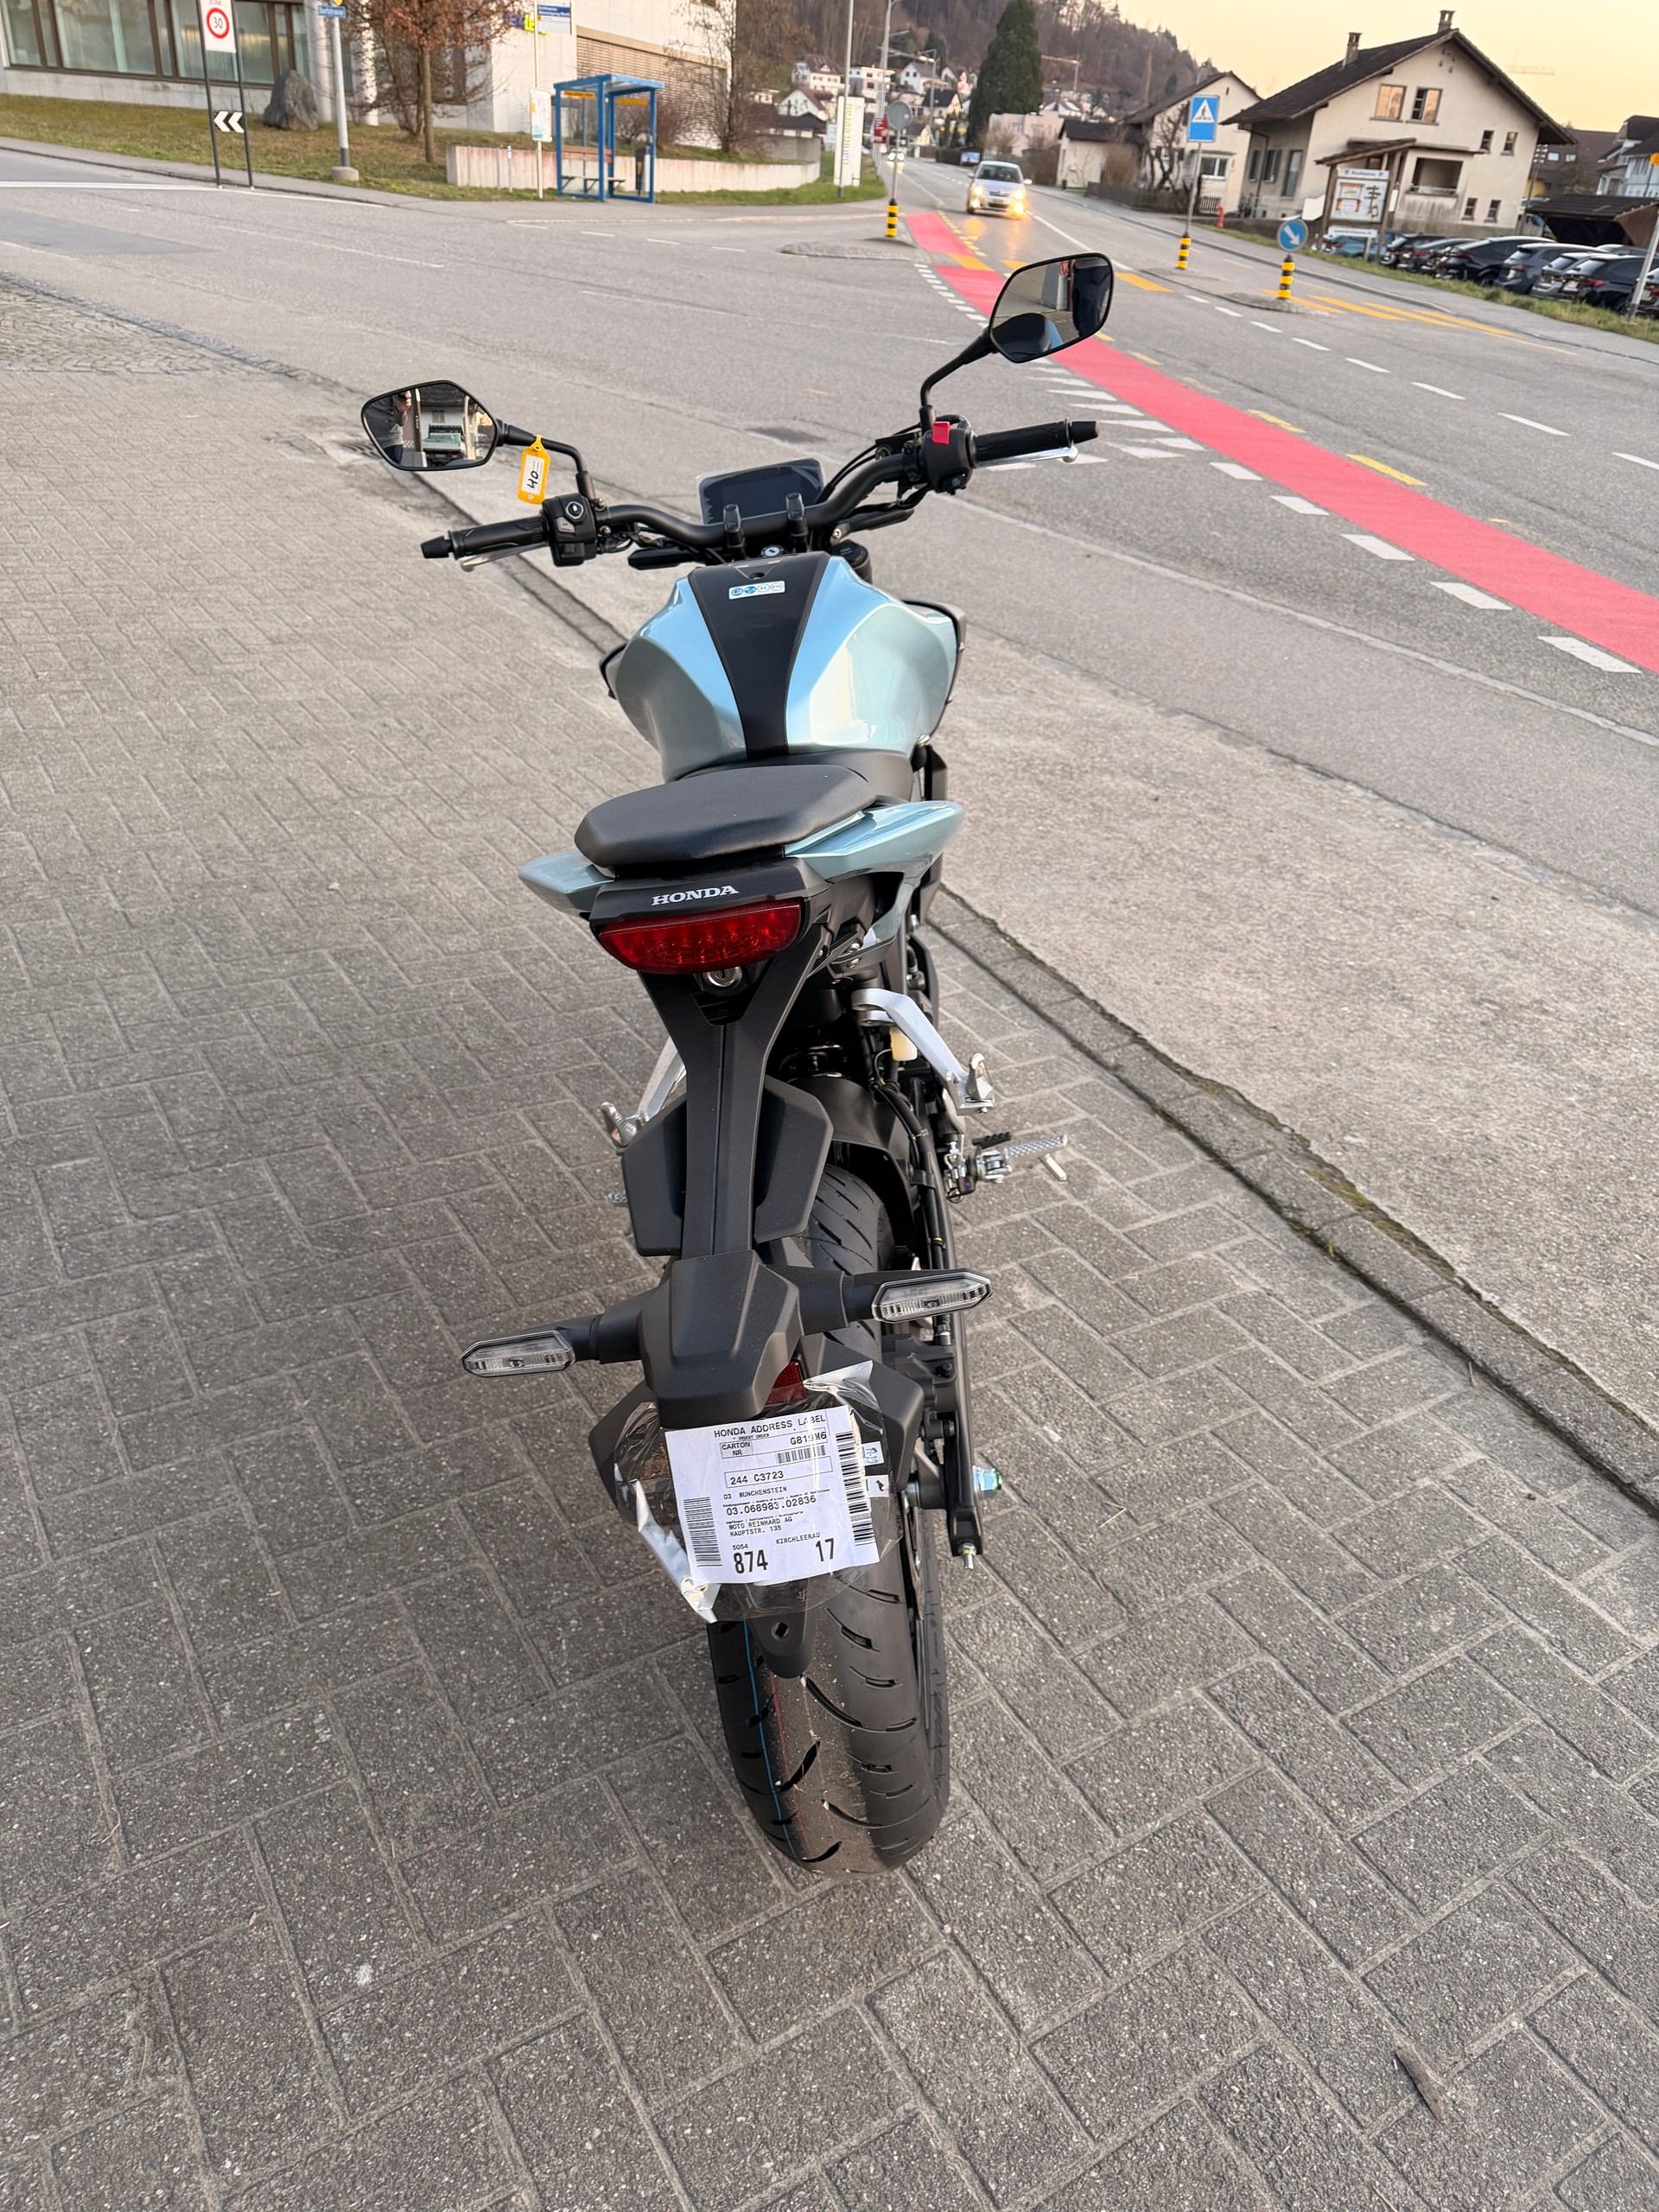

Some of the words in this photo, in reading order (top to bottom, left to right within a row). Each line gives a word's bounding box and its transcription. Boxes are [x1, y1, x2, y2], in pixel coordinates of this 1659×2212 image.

[213, 16, 223, 29] 30
[527, 470, 538, 489] 40
[651, 885, 740, 906] HONDA
[714, 1427, 746, 1438] HONDA
[751, 1420, 793, 1433] ADDRESS
[721, 1441, 751, 1451] CARTON
[730, 1476, 748, 1485] 244
[753, 1471, 784, 1482] C3723
[726, 1495, 817, 1516] 03.068983.02836
[748, 1518, 780, 1528] REINHARD
[730, 1528, 765, 1536] HAUPTSTR.
[776, 1532, 820, 1544] KIRCHLEERAU
[733, 1549, 768, 1573] 874
[816, 1538, 834, 1562] 17
